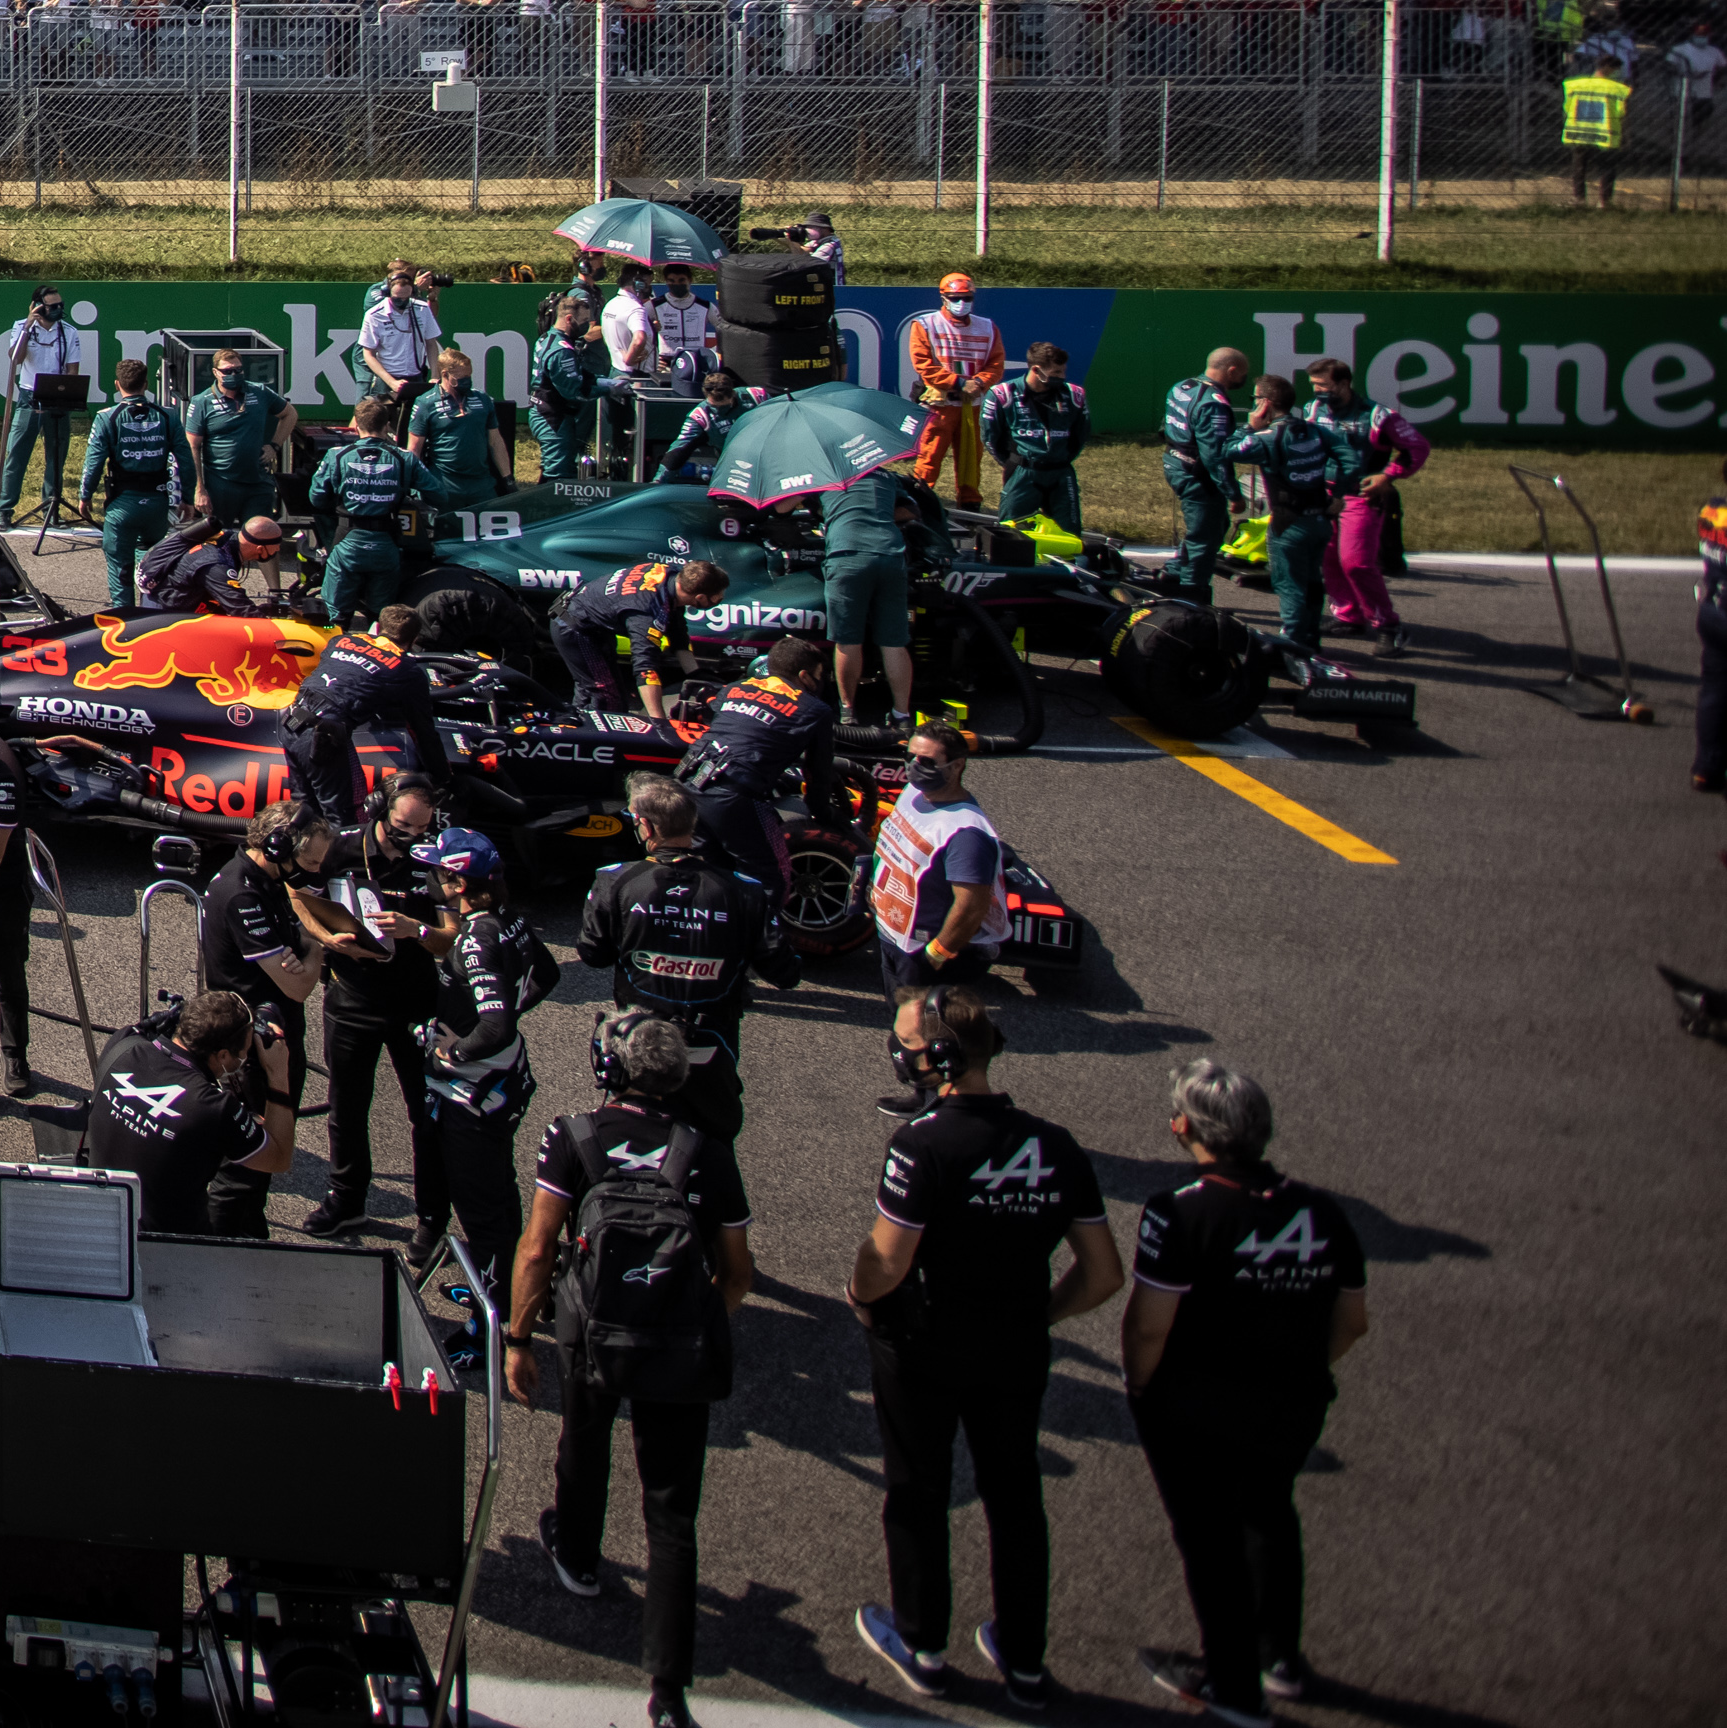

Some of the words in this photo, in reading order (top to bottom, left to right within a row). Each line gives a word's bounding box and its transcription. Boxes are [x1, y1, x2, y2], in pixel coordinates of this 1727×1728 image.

[606, 239, 634, 252] BWT
[775, 294, 798, 304] LEFT
[800, 294, 825, 305] FRONT
[782, 359, 810, 370] RIGHT
[812, 358, 831, 368] REAR
[119, 434, 140, 443] ASTON
[142, 434, 164, 442] MARTIN
[121, 448, 164, 460] Cognizant
[850, 446, 883, 466] Cognizant
[370, 478, 398, 486] MARTIN
[554, 482, 611, 498] PERONI
[780, 474, 813, 490] BWT
[346, 490, 396, 503] Cognizant
[456, 510, 522, 542] 18
[518, 569, 581, 590] BWT
[684, 602, 826, 632] ognizan
[1110, 628, 1128, 658] FRONT
[1, 635, 68, 676] 33
[1308, 688, 1350, 700] ASTON
[1352, 690, 1407, 704] MARTIN
[18, 696, 156, 728] HONDA
[234, 706, 246, 724] E
[479, 739, 616, 764] ORACLE
[150, 746, 260, 820] Red
[412, 848, 428, 859] 14
[630, 902, 728, 922] ALPINE
[672, 921, 702, 931] TEAM
[1050, 922, 1061, 944] 1
[464, 954, 479, 968] citi
[652, 954, 718, 977] Castrol
[102, 1088, 176, 1140] ALPINE
[123, 1118, 148, 1138] TEAM
[968, 1190, 1060, 1206] ALPINE
[1236, 1264, 1332, 1282] ALPINE
